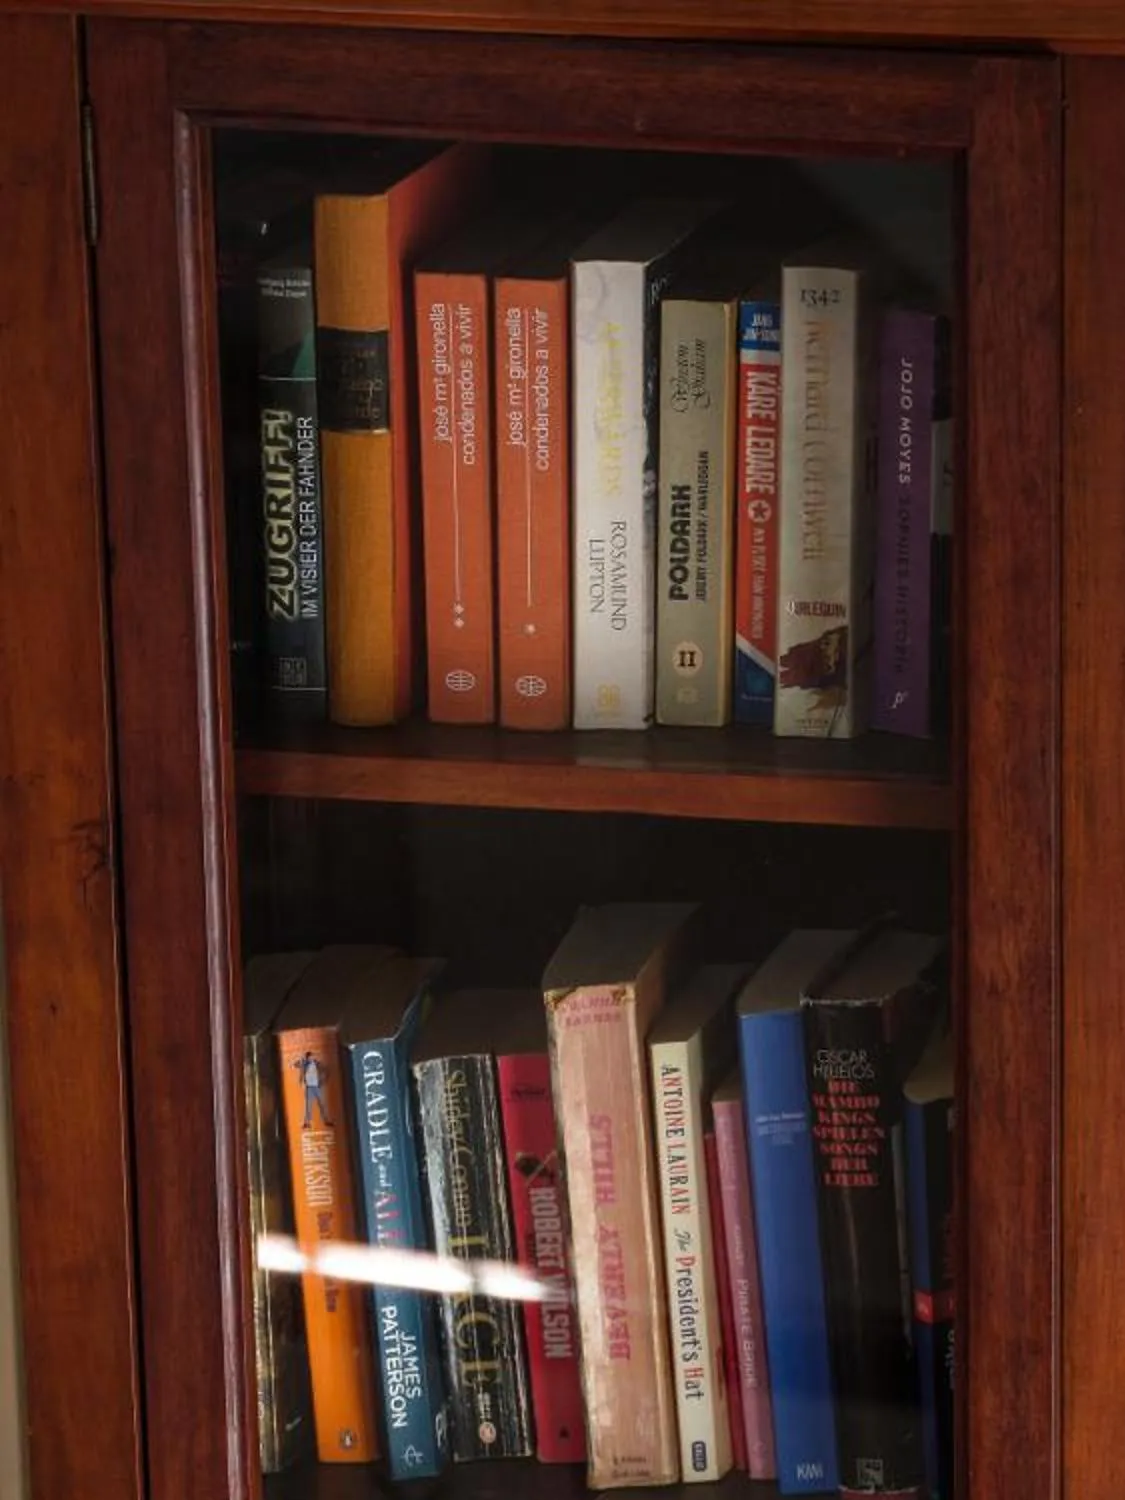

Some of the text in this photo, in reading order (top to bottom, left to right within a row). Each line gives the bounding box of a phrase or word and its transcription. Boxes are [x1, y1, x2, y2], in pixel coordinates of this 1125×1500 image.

[428, 302, 451, 377] gironella
[457, 302, 473, 339] vivir
[506, 306, 528, 379] gironella
[531, 308, 549, 343] vivir
[457, 358, 476, 466] condenados
[533, 362, 550, 473] condenados
[746, 424, 776, 494] LEDARE
[898, 355, 914, 486] JOJO MOYES
[260, 407, 298, 622] ZUGRIFF!
[296, 416, 319, 619] IM VISIER DER FAHNDER
[668, 485, 692, 601] POLDARK
[589, 537, 607, 614] LUPTON
[609, 518, 627, 631] ROSAMUND
[361, 1049, 395, 1164] CRADLE
[660, 1065, 687, 1138] ANTOINE
[300, 1130, 335, 1209] Clarkson
[666, 1141, 692, 1216] LAURAIN
[529, 1186, 566, 1269] ROBERT
[590, 1114, 631, 1361] BEVERLY HILLS
[447, 1235, 502, 1387] LCE
[674, 1254, 699, 1364] President's
[381, 1304, 409, 1429] PATTERSON
[399, 1330, 423, 1401] JAMES
[683, 1366, 705, 1401] Hat
